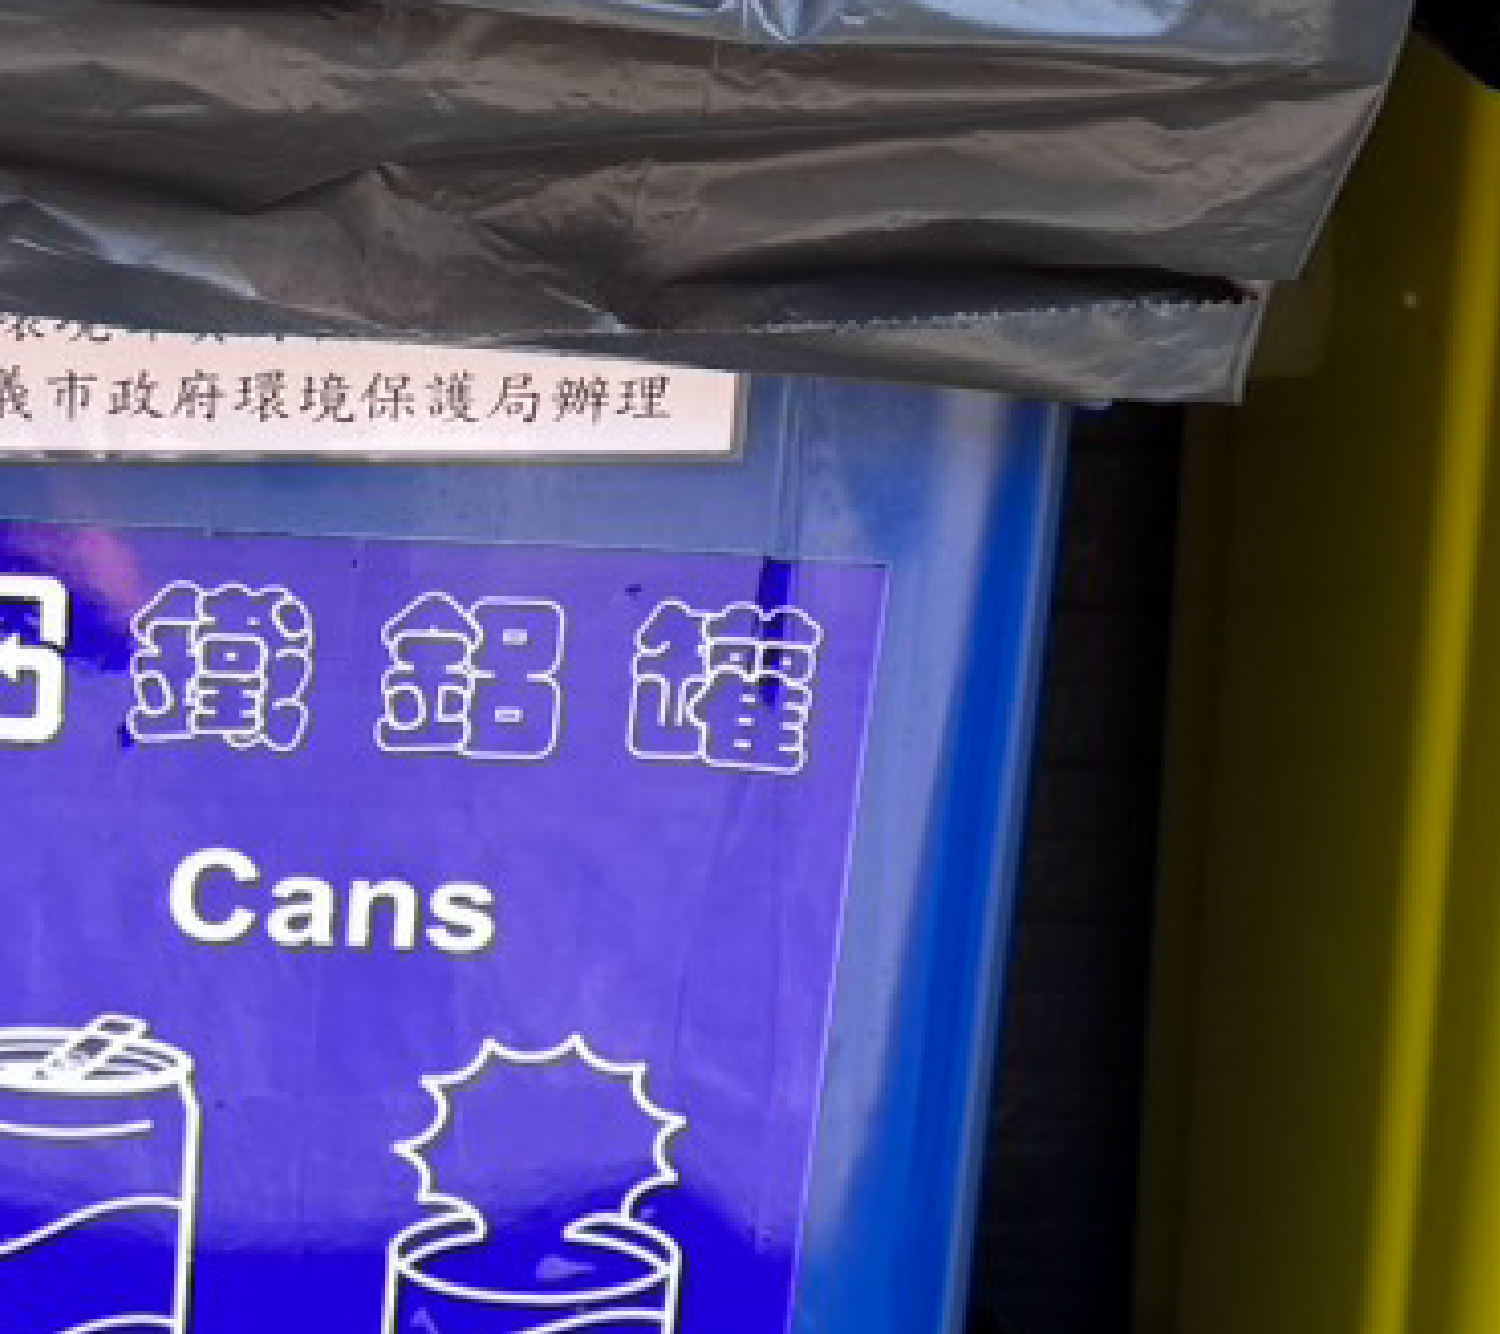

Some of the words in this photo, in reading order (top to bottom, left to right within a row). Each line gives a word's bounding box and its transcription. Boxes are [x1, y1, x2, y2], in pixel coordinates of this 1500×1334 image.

[125, 579, 823, 774] 鐵鋁罐
[168, 846, 499, 955] Cans
